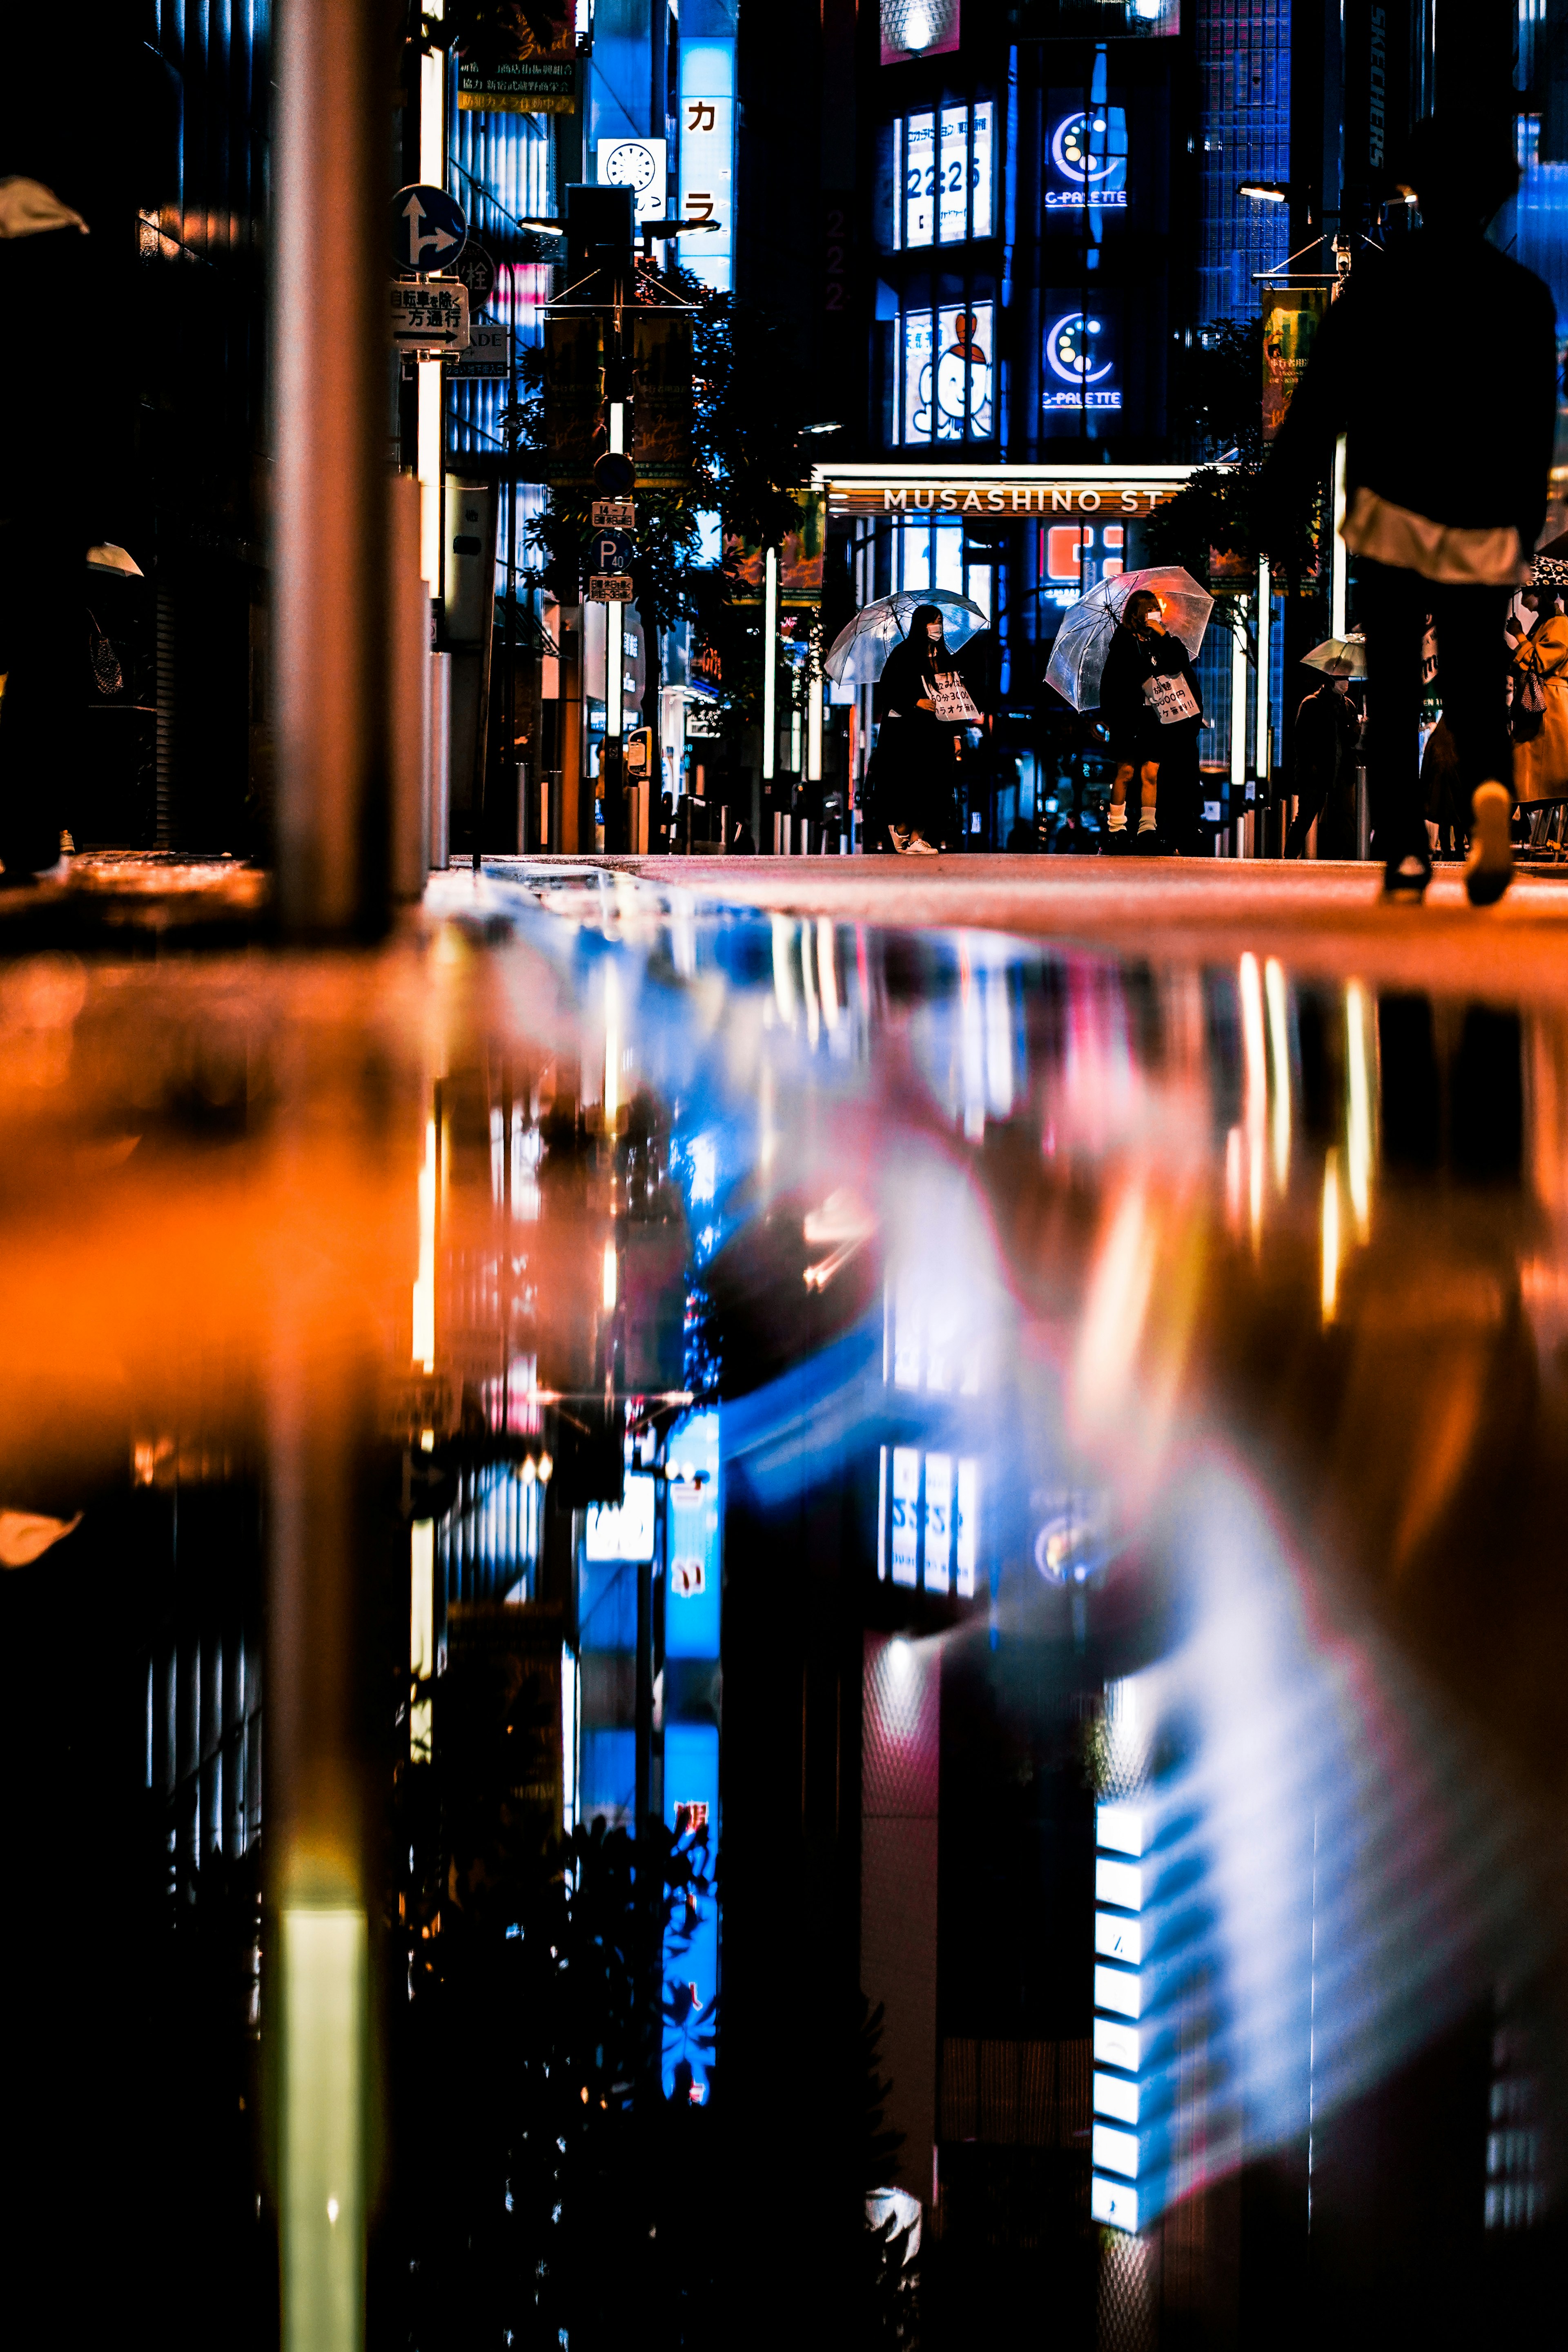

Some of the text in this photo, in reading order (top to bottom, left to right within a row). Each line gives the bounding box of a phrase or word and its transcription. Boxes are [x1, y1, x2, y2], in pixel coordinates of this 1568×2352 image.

[1370, 4, 1385, 168] SKECHERS
[391, 290, 460, 308] 自転車を除く
[391, 310, 461, 327] 一方通行
[884, 489, 1101, 512] MUSASHINO
[600, 506, 608, 515] 14
[621, 506, 627, 515] 7
[600, 541, 617, 568] P
[612, 556, 624, 568] 40
